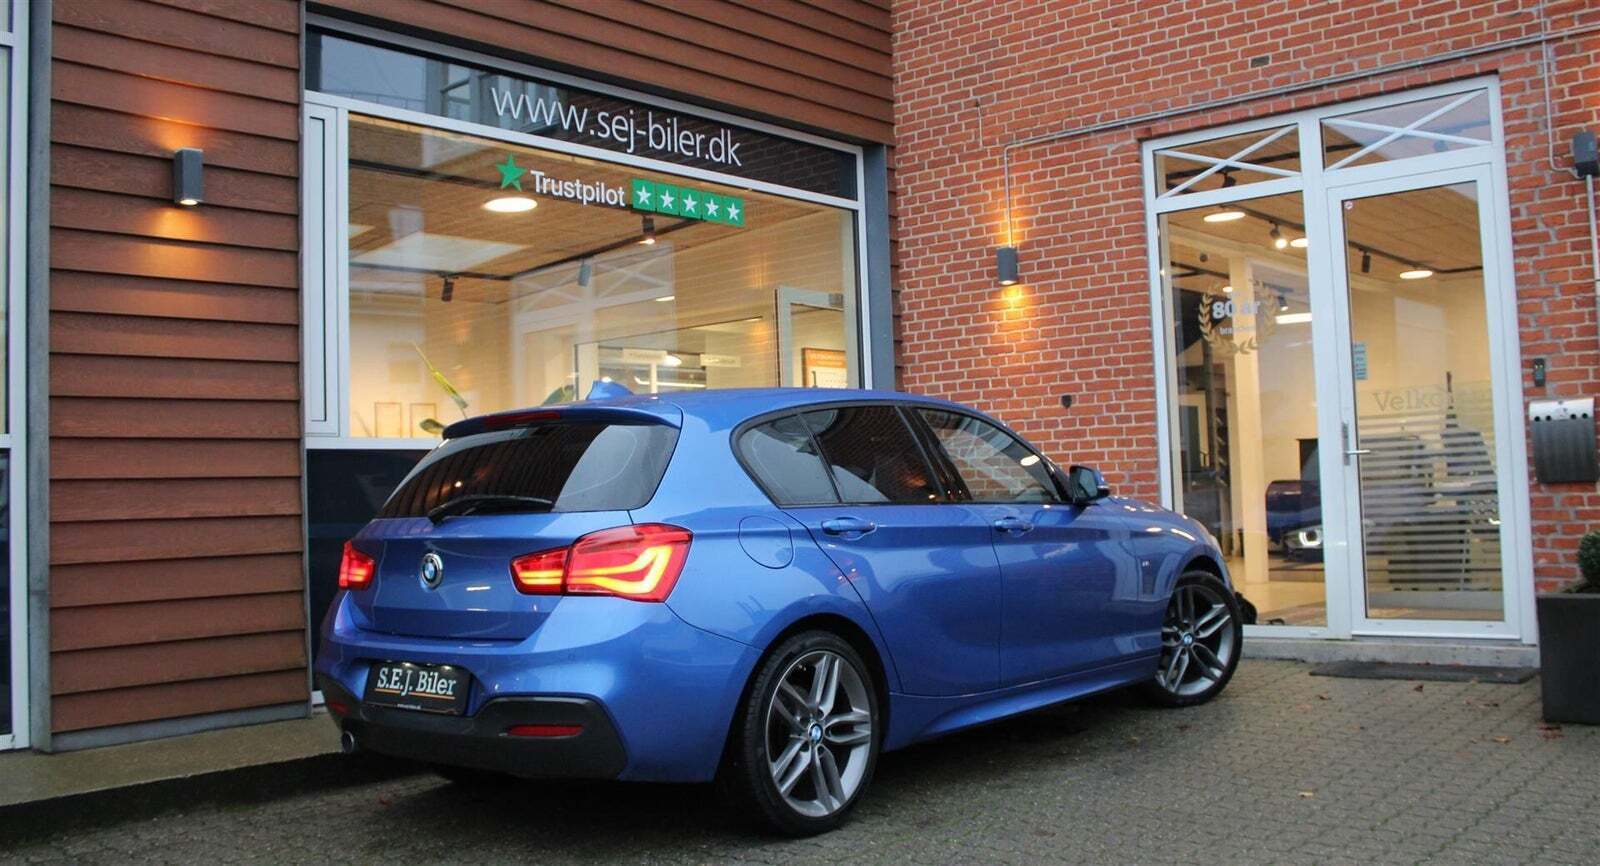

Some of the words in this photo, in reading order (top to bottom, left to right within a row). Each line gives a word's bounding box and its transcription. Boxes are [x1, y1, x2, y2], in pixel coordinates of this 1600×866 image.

[491, 87, 742, 166] www.sej-biler.dk
[530, 170, 626, 206] Trustpilot
[1212, 300, 1236, 319] 80
[376, 667, 413, 696] S.E.J.
[416, 671, 457, 695] Biler
